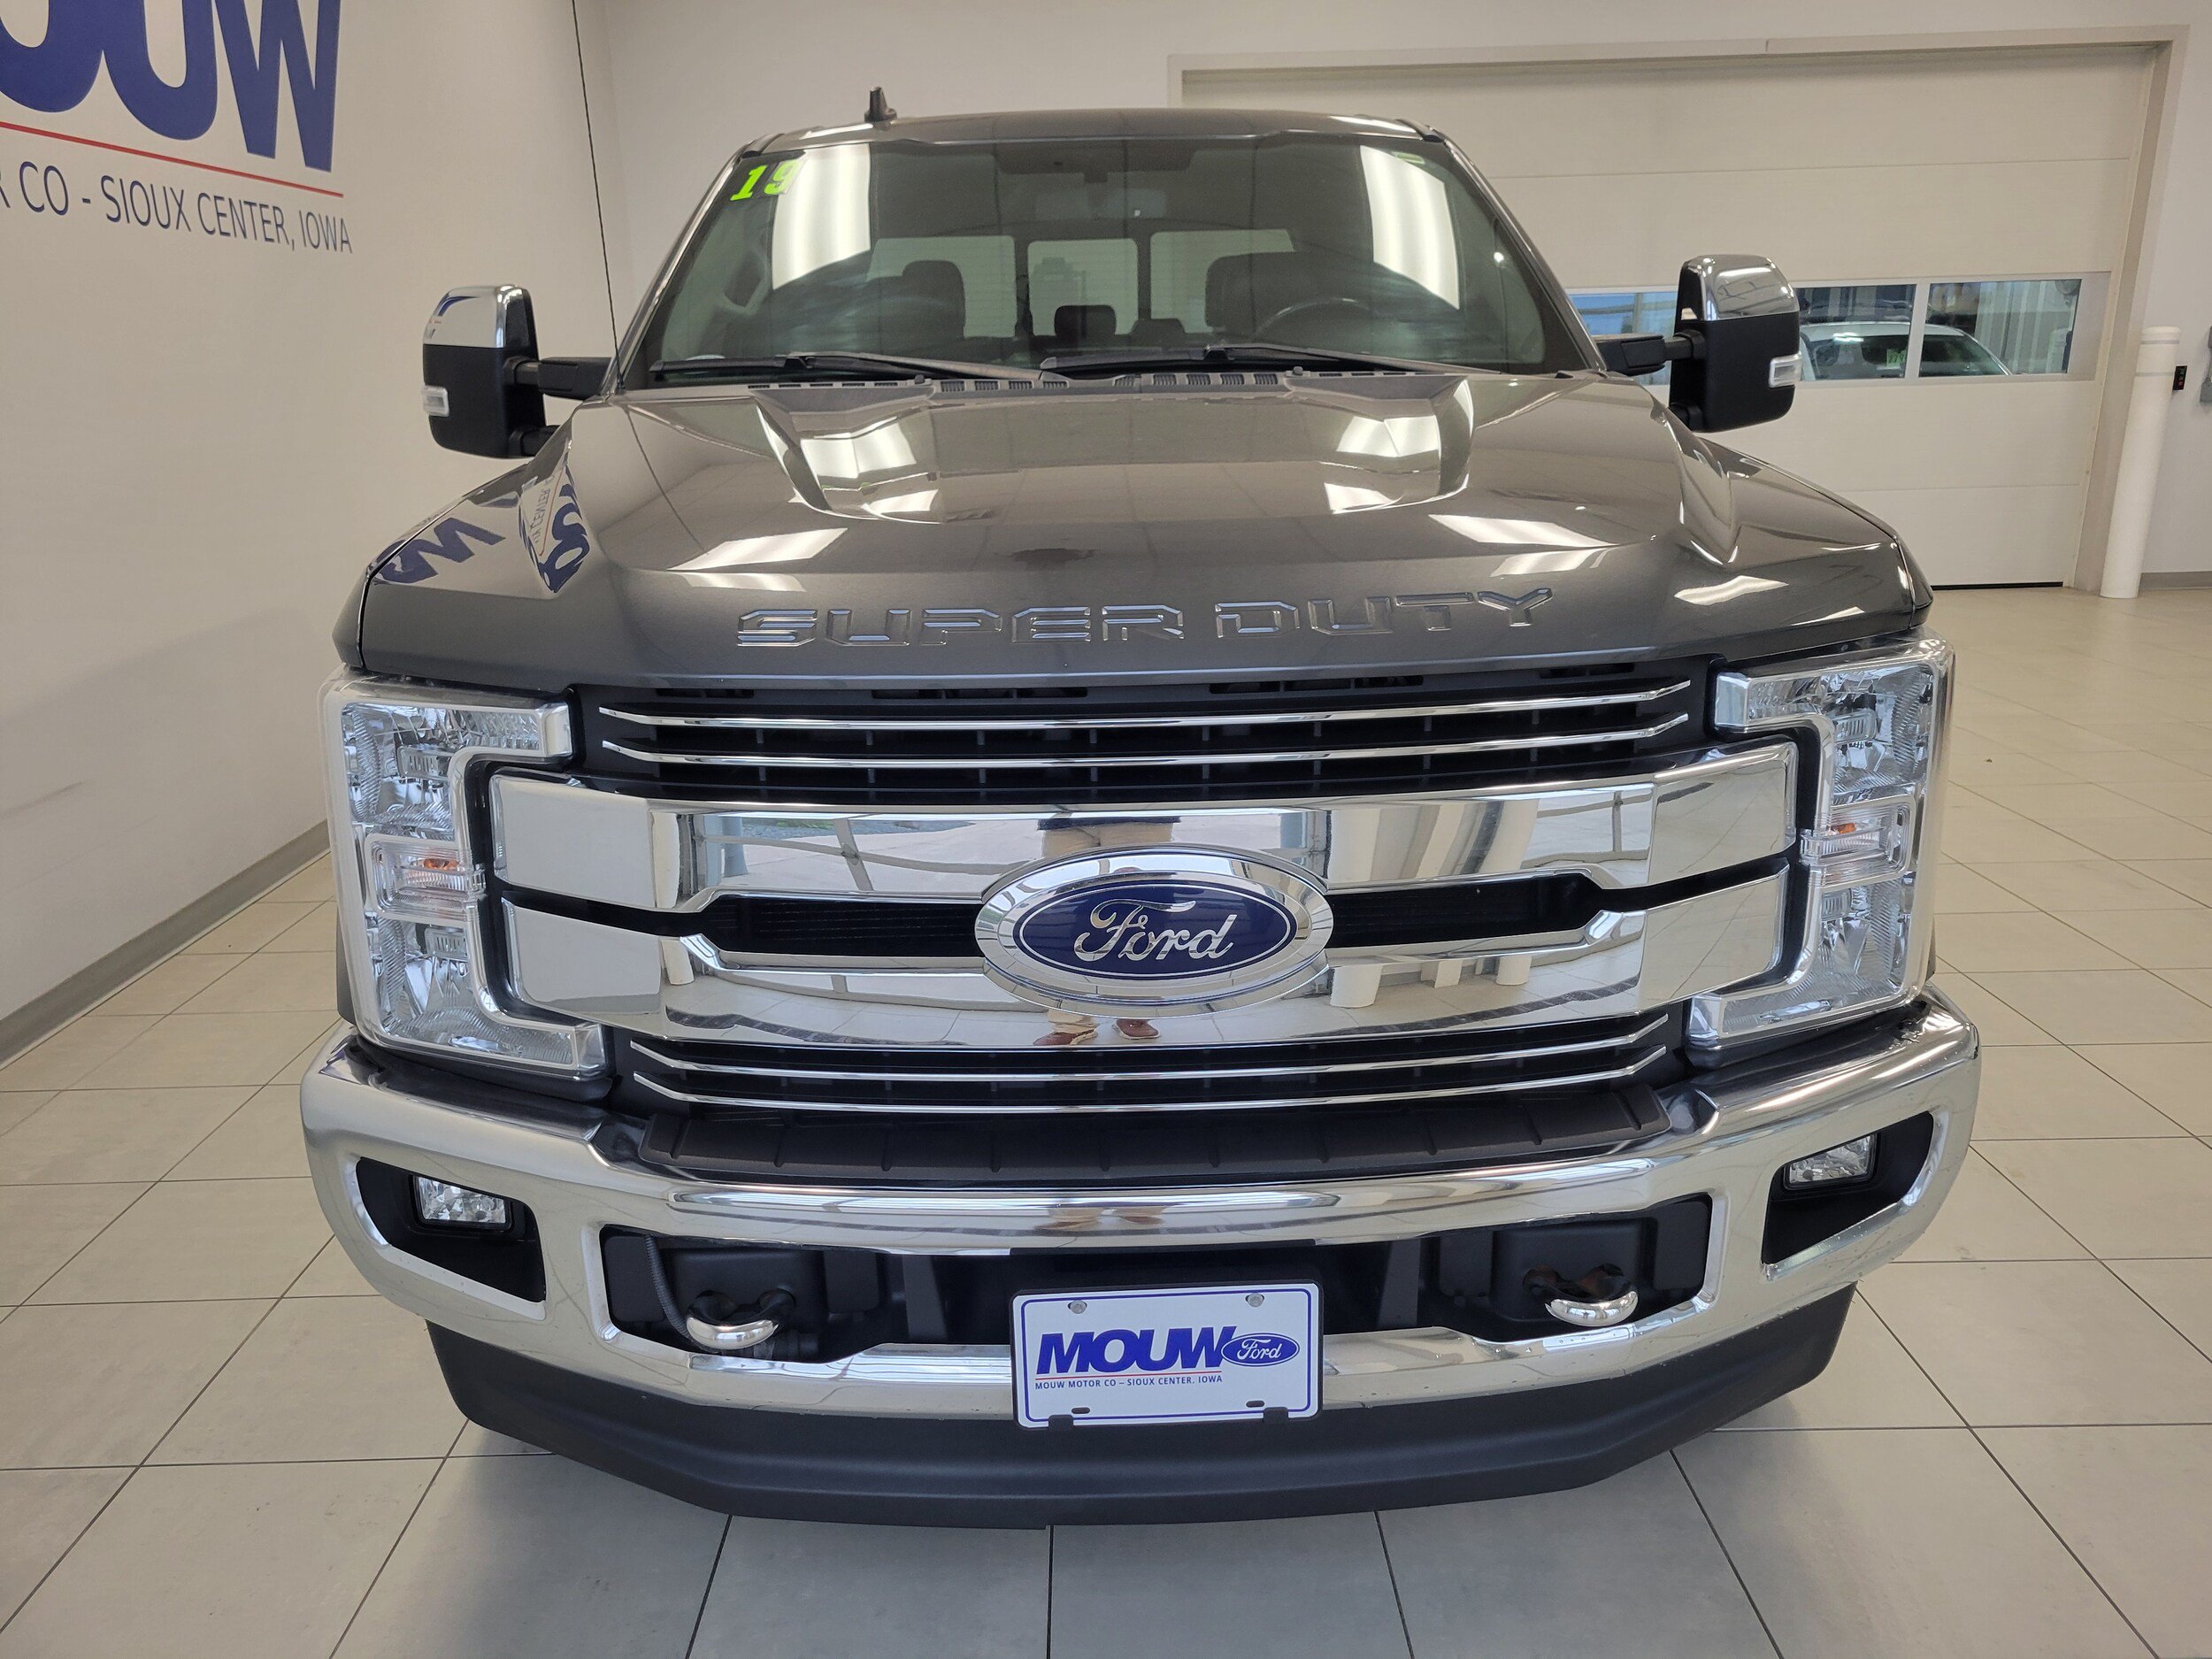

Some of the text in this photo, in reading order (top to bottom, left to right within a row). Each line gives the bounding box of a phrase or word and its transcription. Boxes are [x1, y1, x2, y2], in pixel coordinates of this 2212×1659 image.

[730, 159, 803, 201] 19
[19, 161, 69, 216] CO
[101, 174, 192, 232] SIOUX
[197, 192, 296, 252] CENTER,
[299, 210, 353, 254] IOWA
[737, 588, 1553, 647] SUPER DUTY
[1073, 898, 1238, 962] Ford
[1036, 1325, 1282, 1375] MOUW Ford
[1035, 1381, 1065, 1390] MOUW
[1068, 1379, 1101, 1388] MOTOR
[1126, 1378, 1156, 1386] SIOUX
[1198, 1374, 1223, 1383] IOWA
